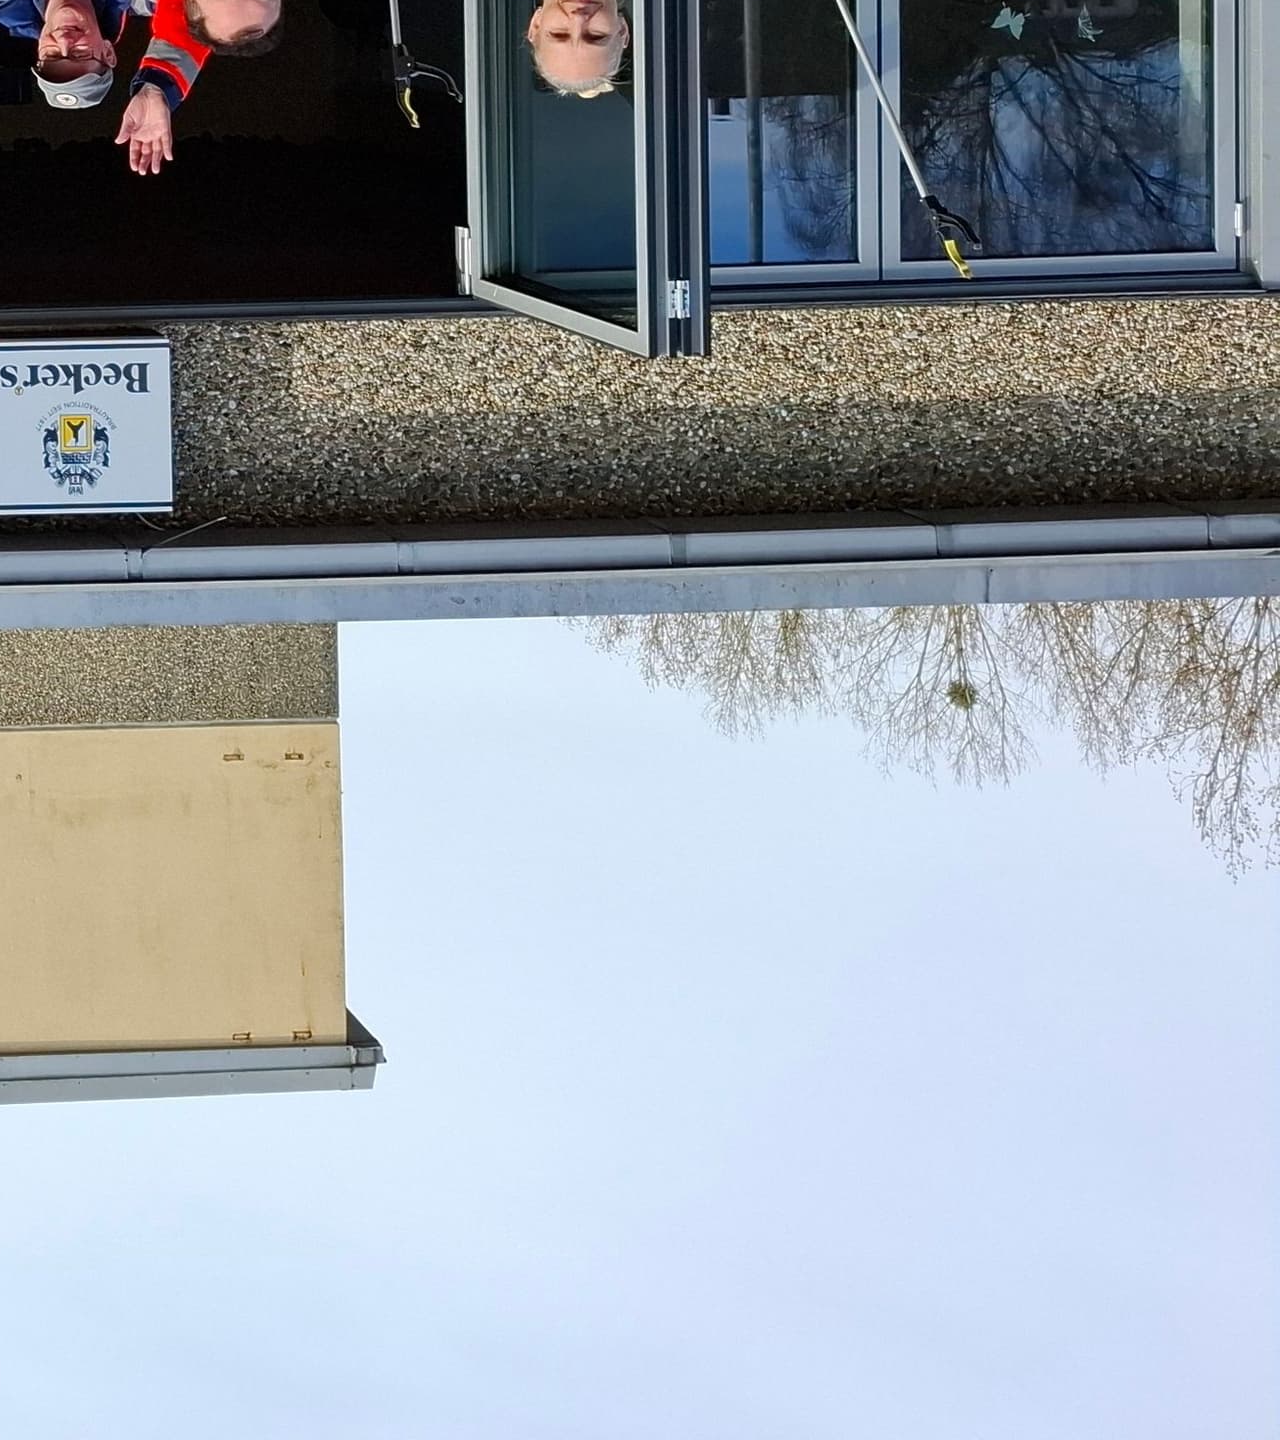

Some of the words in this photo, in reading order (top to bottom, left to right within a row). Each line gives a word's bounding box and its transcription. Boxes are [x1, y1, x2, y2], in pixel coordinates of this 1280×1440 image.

[0, 362, 150, 395] Becker's
[48, 404, 62, 417] SEIT
[63, 401, 117, 431] BRAUTRADITION
